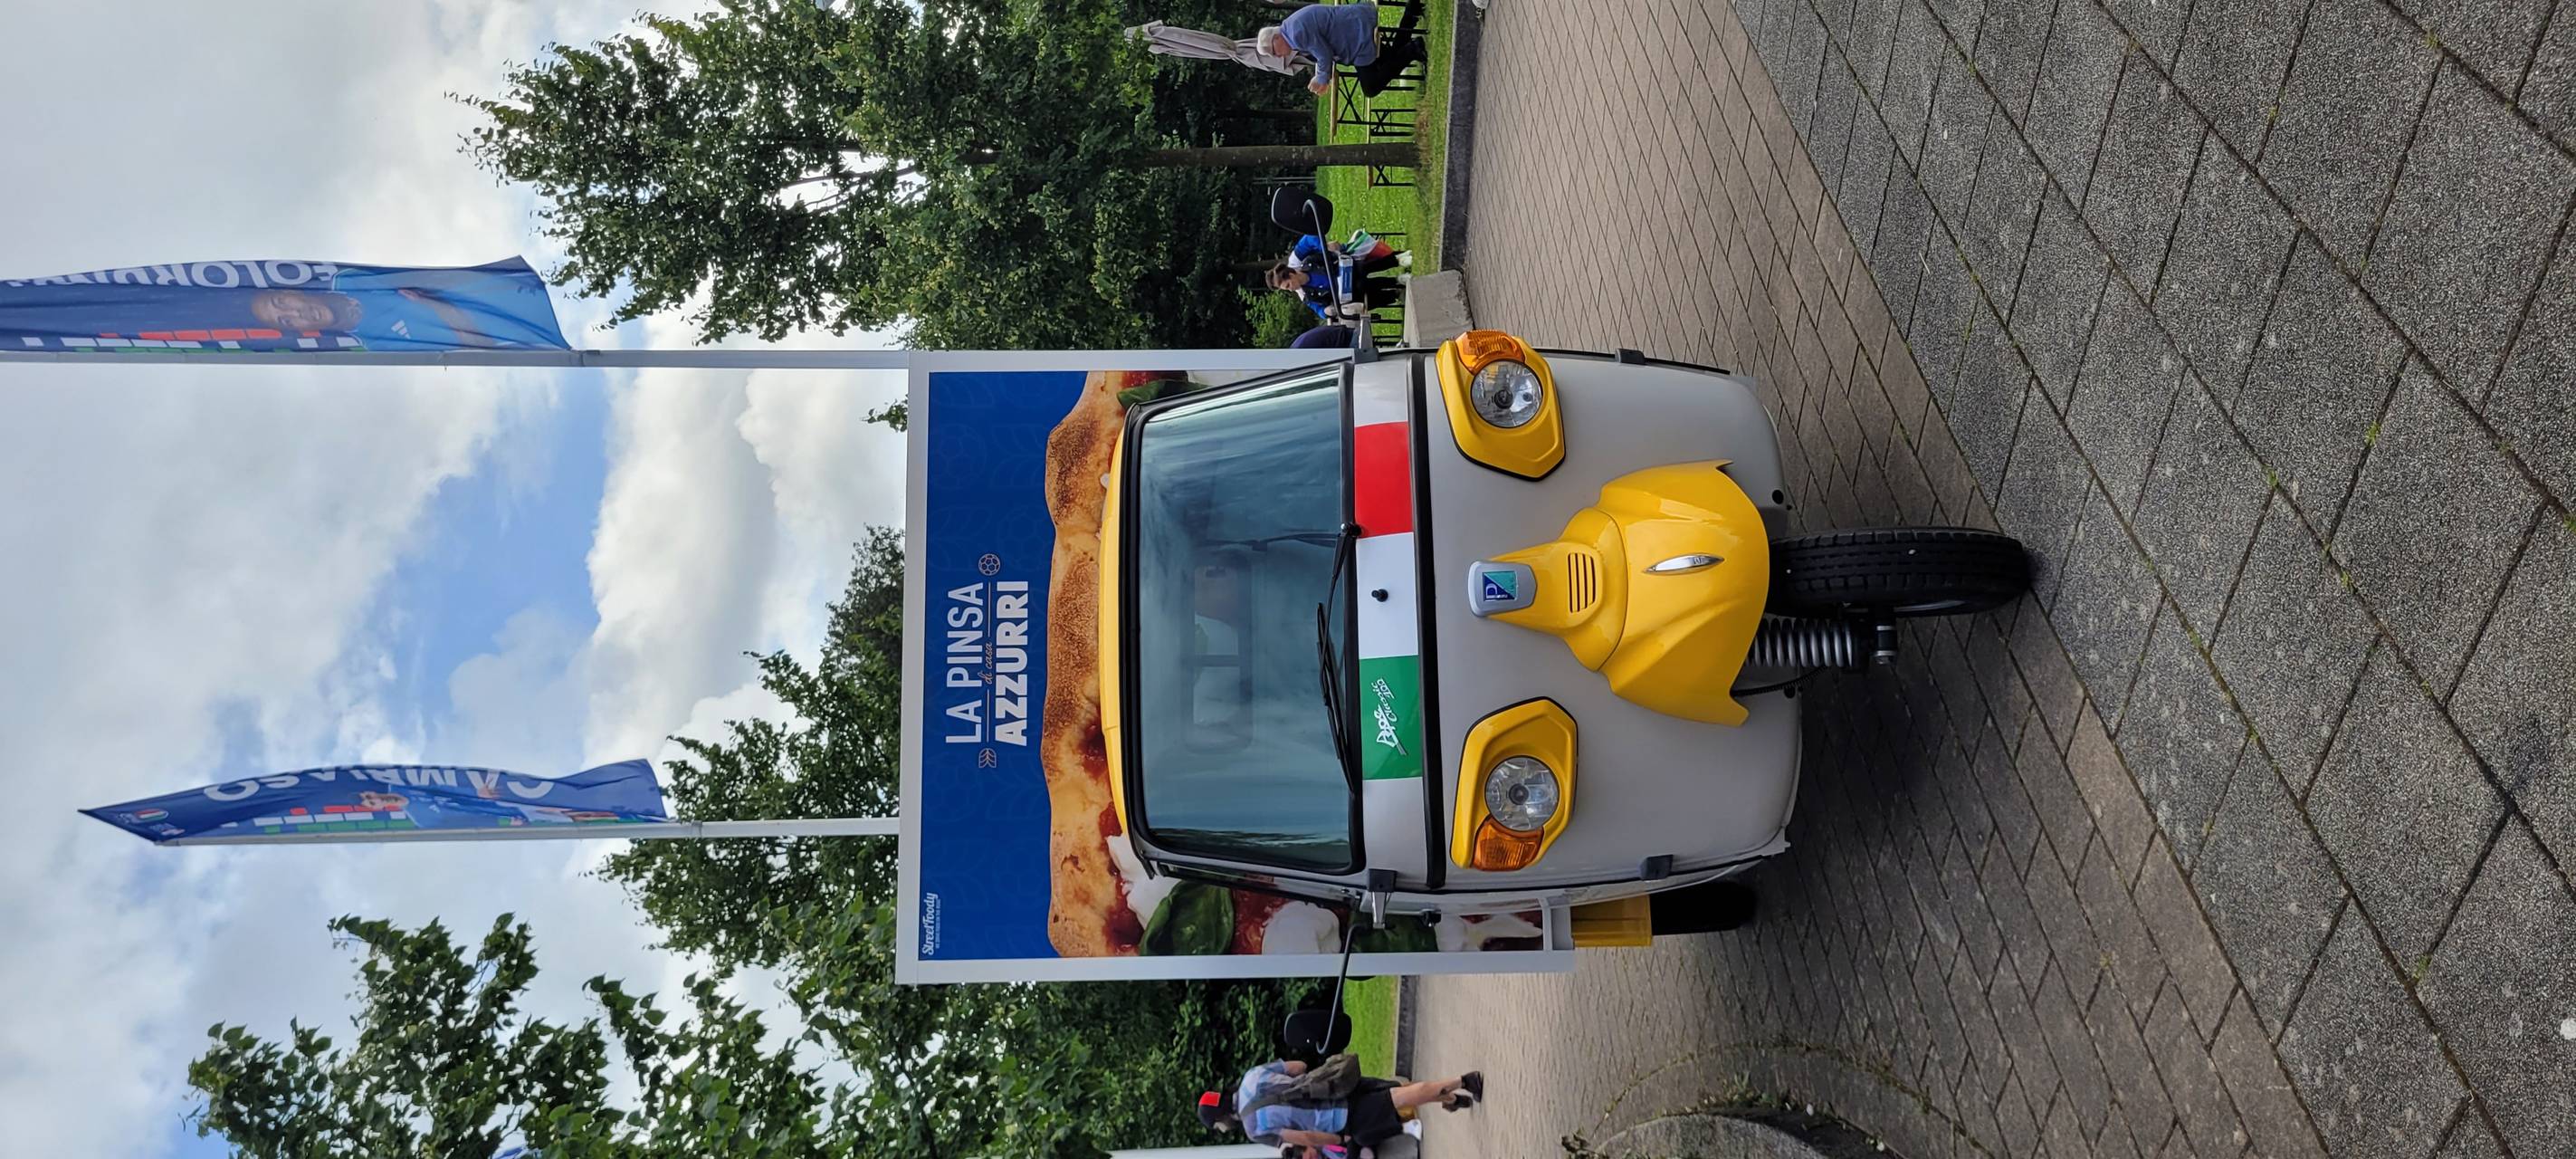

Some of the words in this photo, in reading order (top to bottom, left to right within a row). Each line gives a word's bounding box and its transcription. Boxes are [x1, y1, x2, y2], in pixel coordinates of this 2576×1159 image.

[947, 582, 984, 687] PINSA
[985, 642, 993, 669] casa
[995, 581, 1029, 746] AZZURRI
[945, 699, 982, 742] LA
